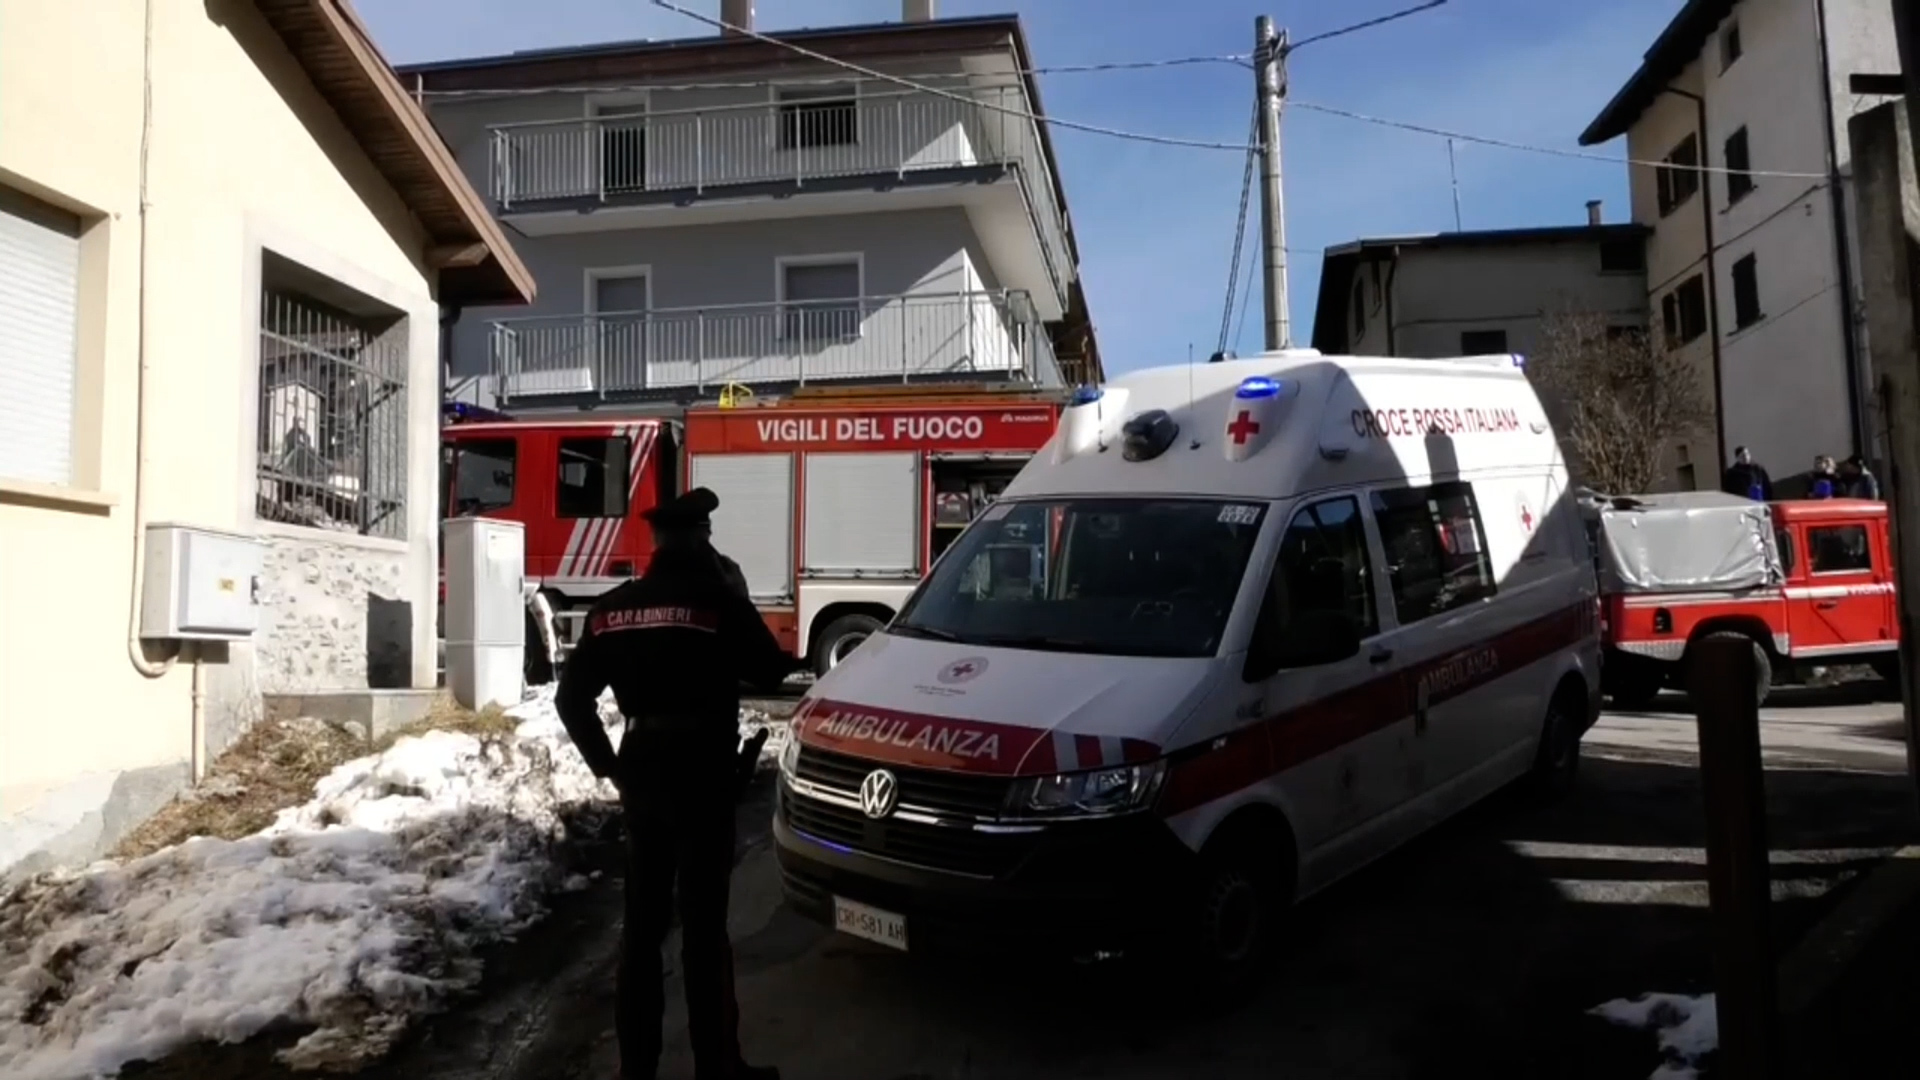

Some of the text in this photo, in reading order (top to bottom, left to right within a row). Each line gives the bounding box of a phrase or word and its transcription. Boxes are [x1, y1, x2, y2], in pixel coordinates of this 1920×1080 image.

[757, 416, 983, 441] VIGILI DEL FUOCO
[1351, 408, 1521, 437] CROCE ROSSA ITALIANA
[607, 607, 691, 626] CARABINIERI
[815, 711, 999, 760] AMBULANZA
